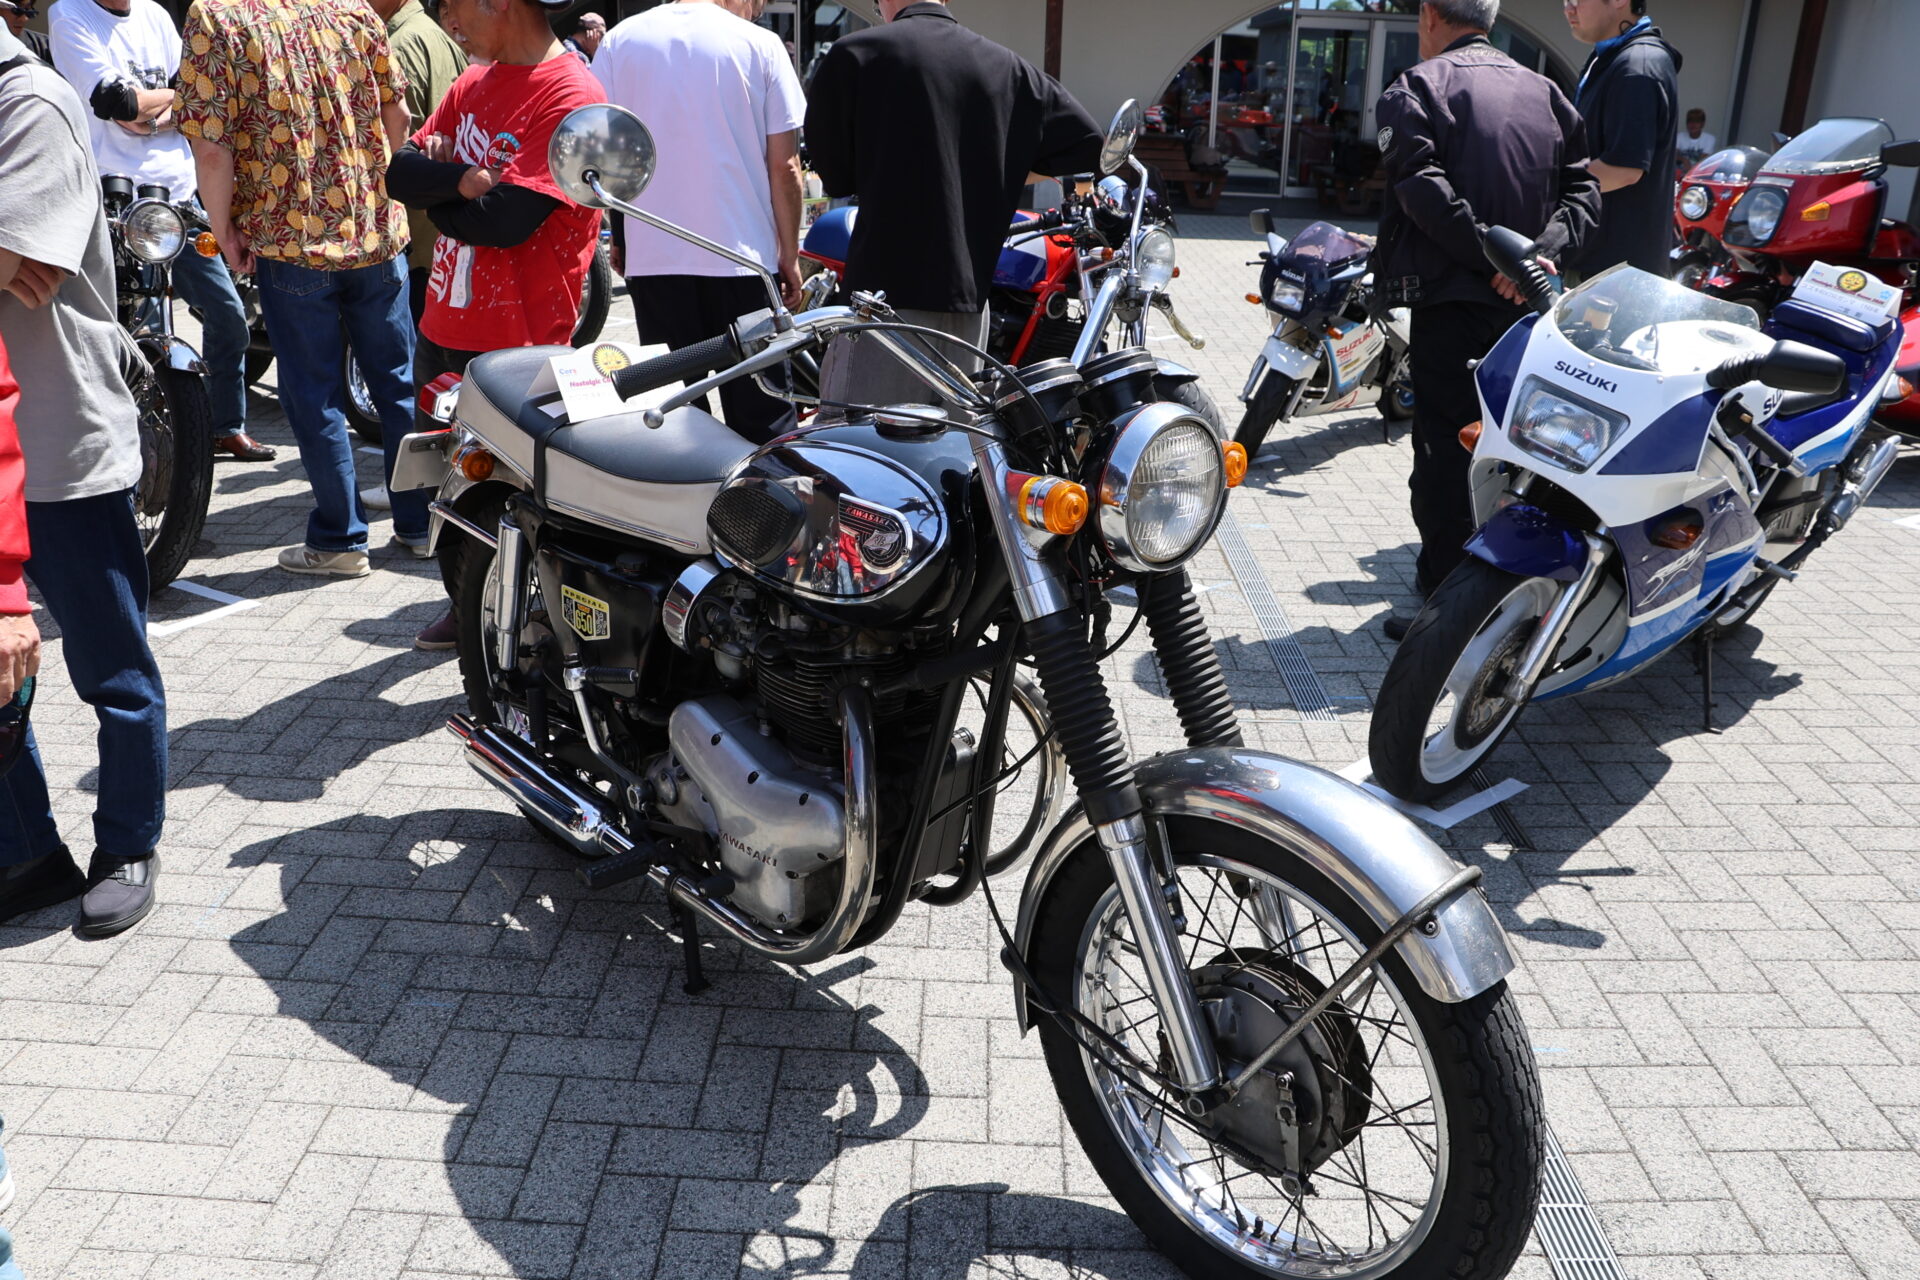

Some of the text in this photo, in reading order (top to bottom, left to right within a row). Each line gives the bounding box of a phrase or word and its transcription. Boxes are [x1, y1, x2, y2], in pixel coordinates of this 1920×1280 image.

[569, 378, 601, 388] Nostalgic
[1554, 360, 1618, 393] SUZUKI
[845, 506, 890, 526] KAWASAKI
[564, 588, 605, 610] SPECIAL
[575, 609, 593, 635] 650
[720, 832, 778, 867] AWASAKI
